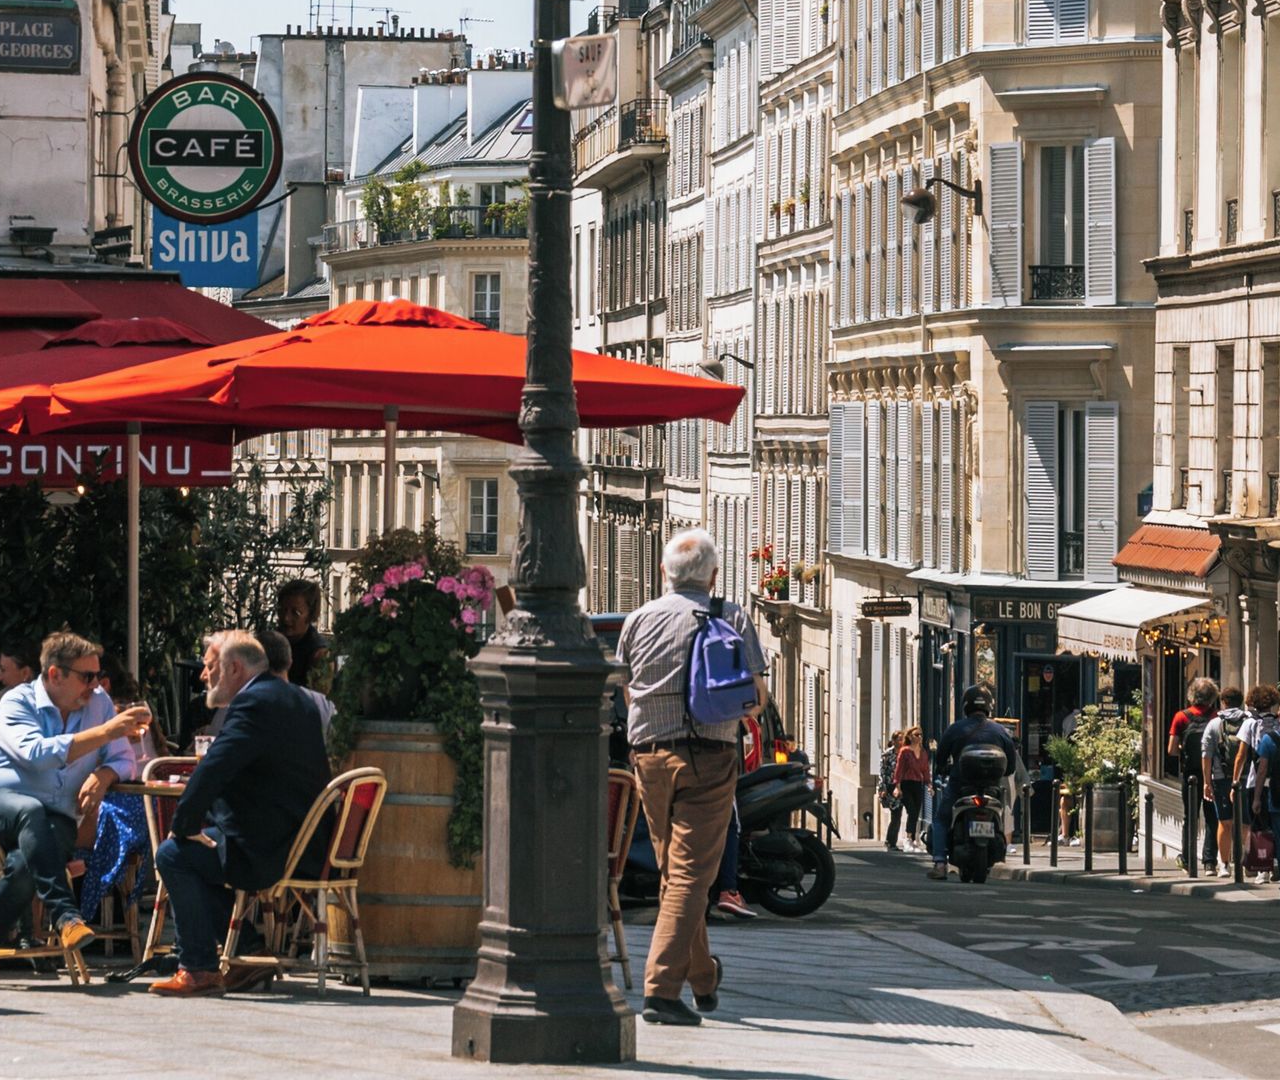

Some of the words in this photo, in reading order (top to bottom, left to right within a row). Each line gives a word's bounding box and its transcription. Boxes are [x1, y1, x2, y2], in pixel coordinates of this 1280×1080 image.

[0, 21, 54, 37] PLACE
[578, 43, 603, 64] SAUF
[172, 85, 240, 110] BAR
[154, 133, 256, 158] CAFÉ
[156, 177, 256, 209] BRASSERIE
[159, 221, 252, 263] shiva
[999, 601, 1014, 618] LE
[1020, 602, 1041, 619] BON
[1047, 603, 1067, 620] GE
